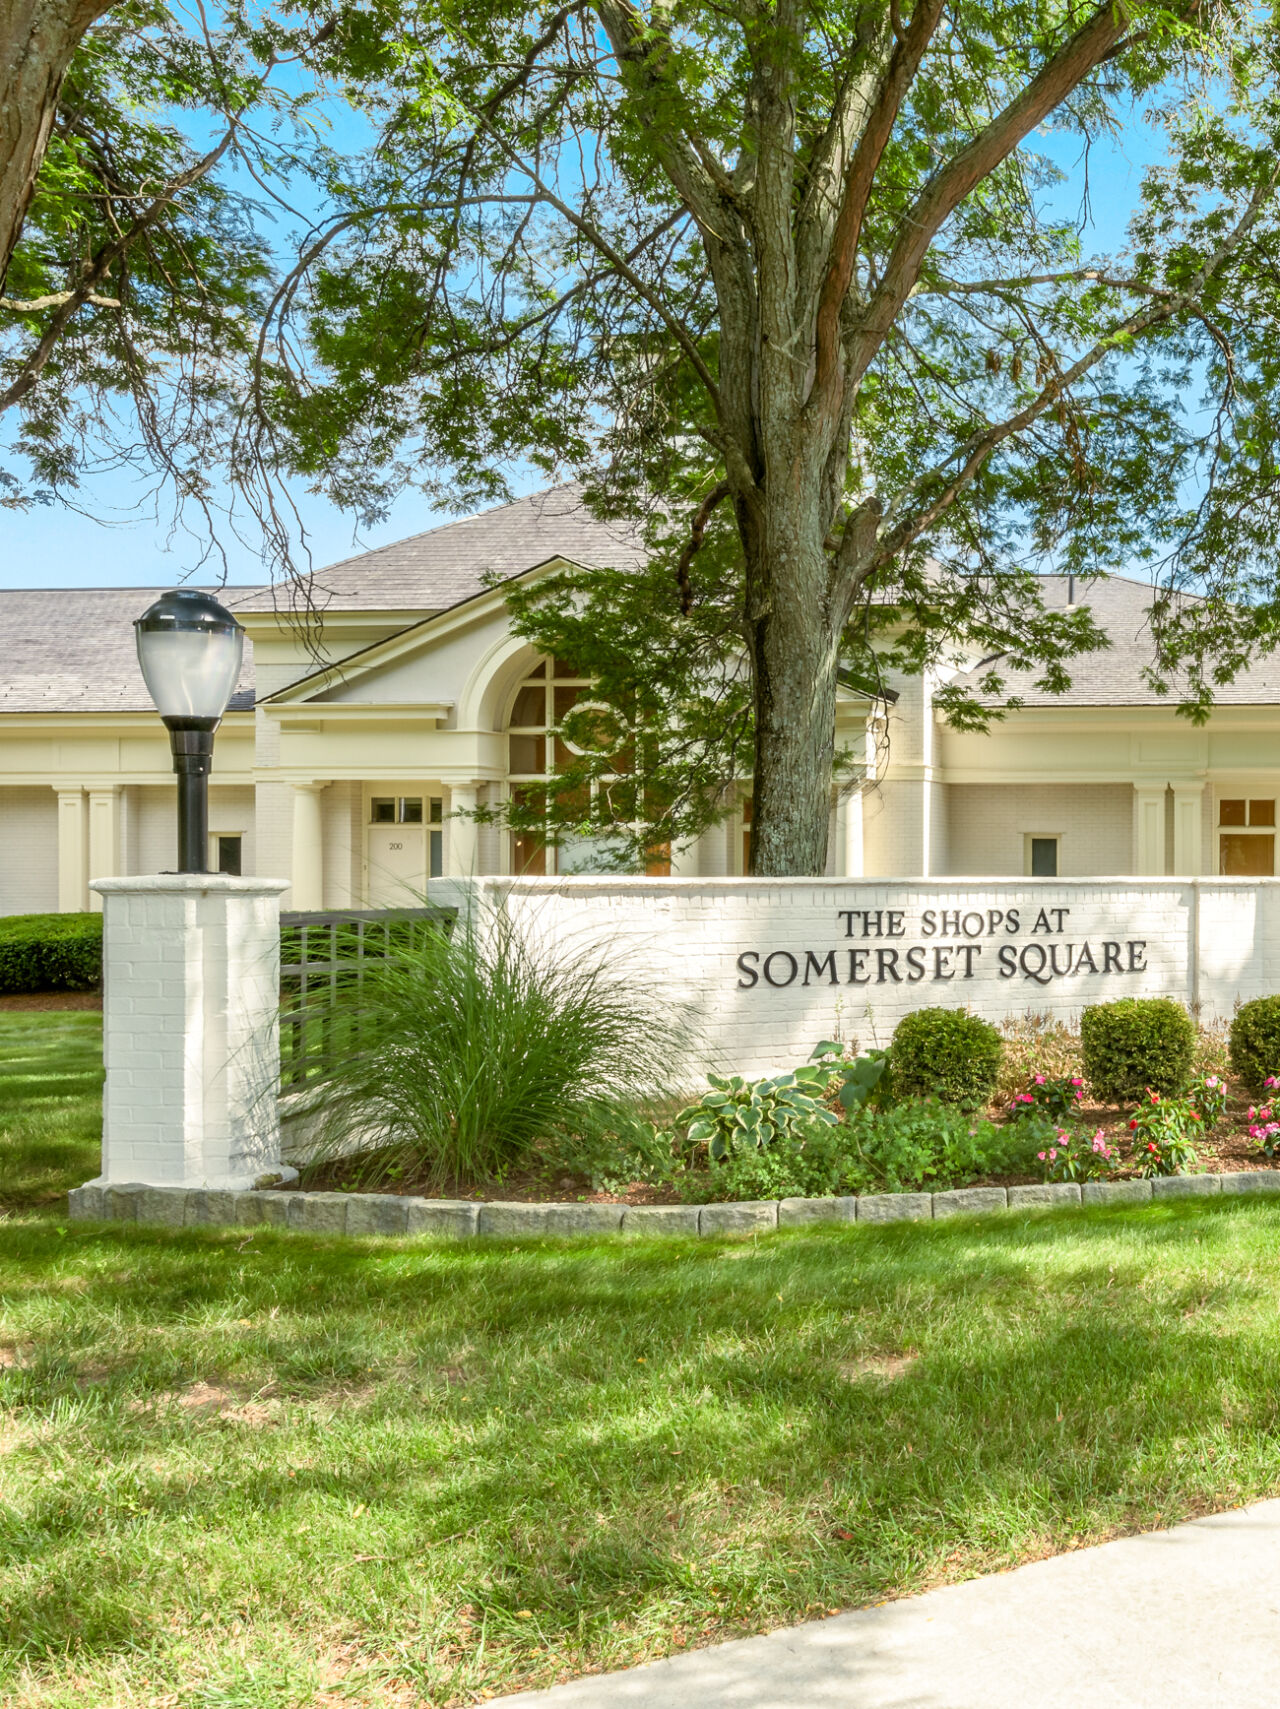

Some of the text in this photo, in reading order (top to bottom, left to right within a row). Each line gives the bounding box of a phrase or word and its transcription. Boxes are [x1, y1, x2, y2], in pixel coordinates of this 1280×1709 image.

[389, 842, 403, 850] 200
[838, 907, 1070, 938] THE SHOPS AT
[736, 940, 1148, 989] SOMERSET SQUARE
